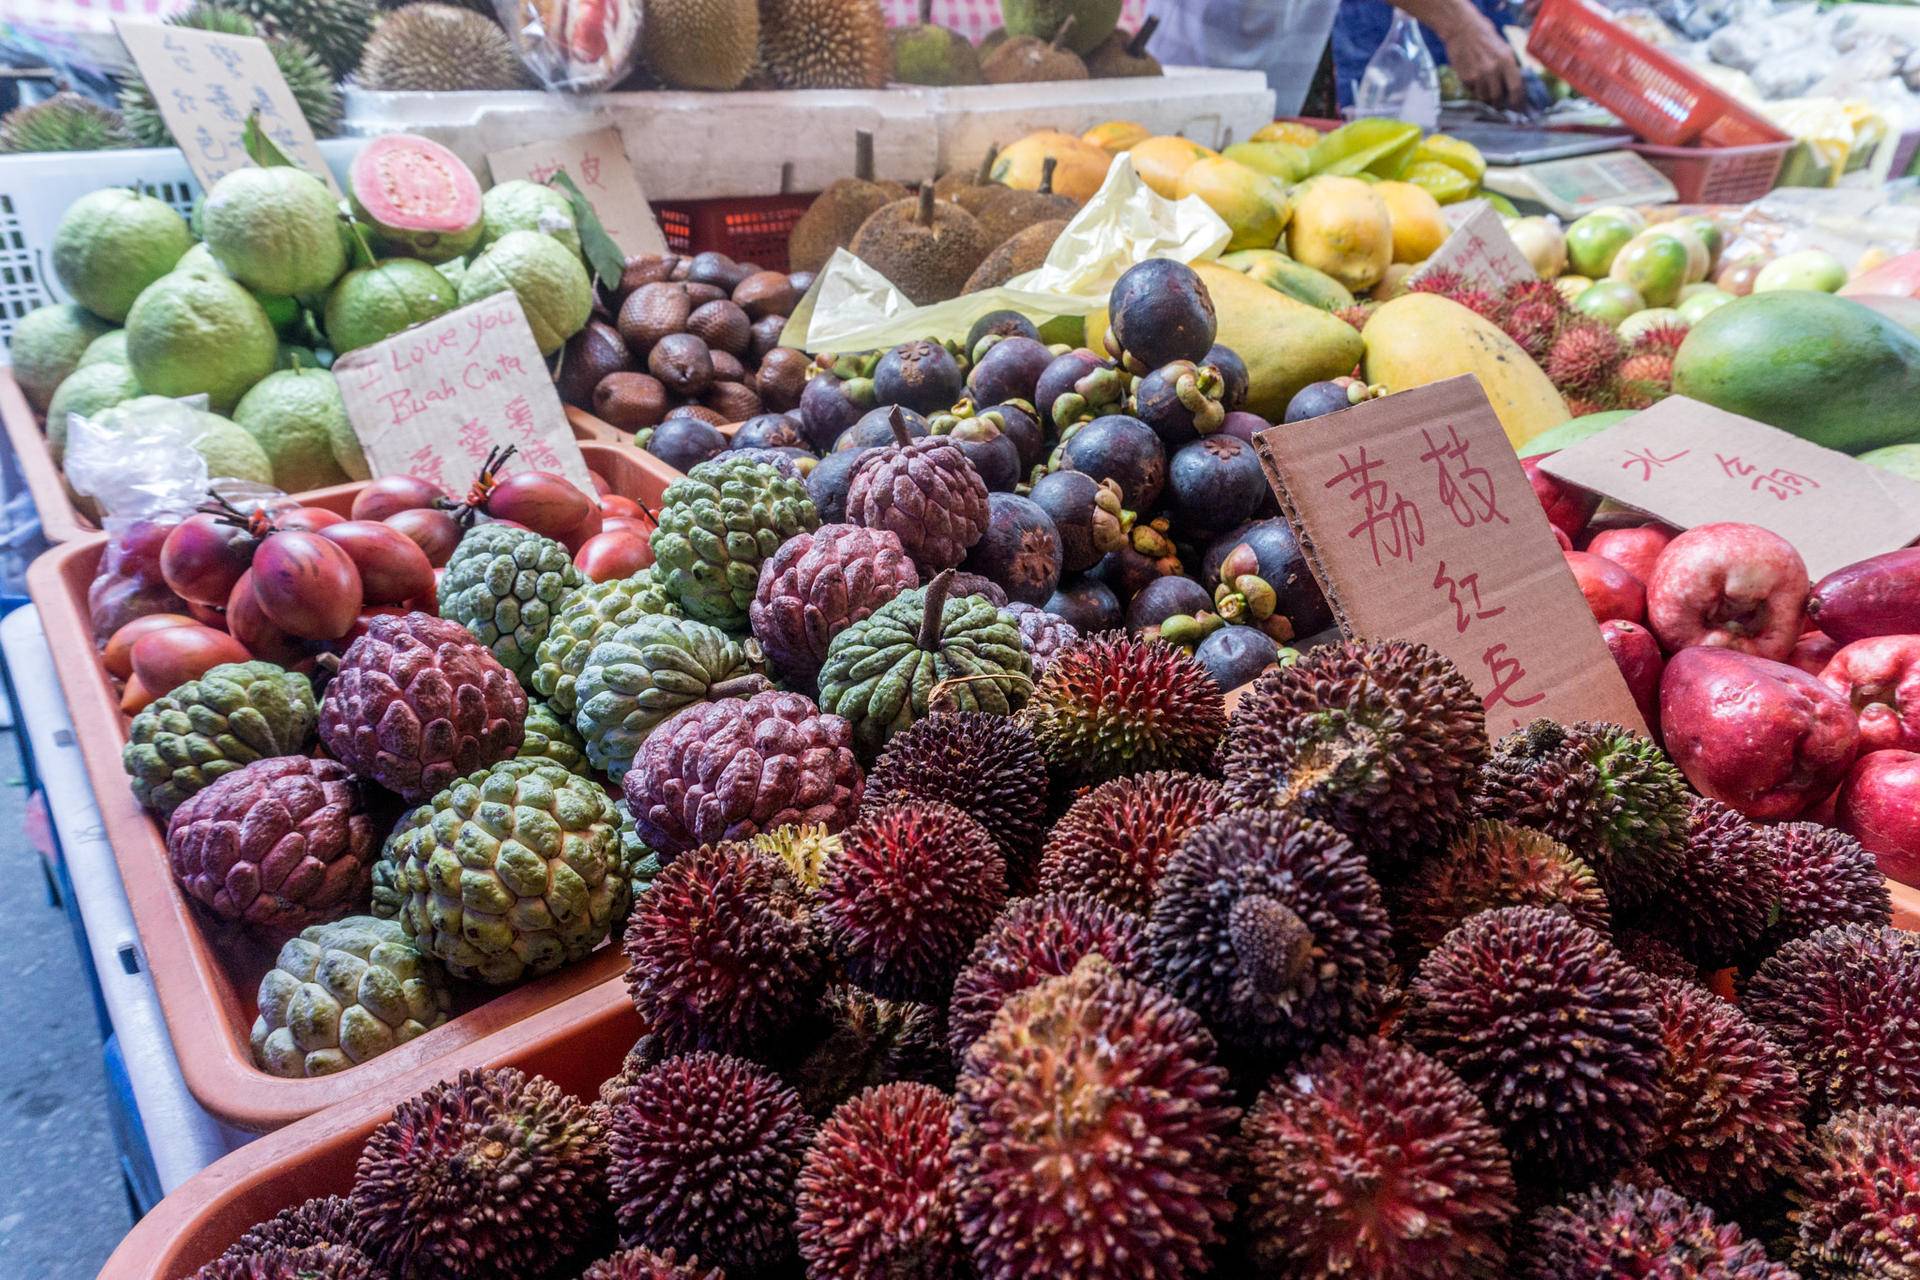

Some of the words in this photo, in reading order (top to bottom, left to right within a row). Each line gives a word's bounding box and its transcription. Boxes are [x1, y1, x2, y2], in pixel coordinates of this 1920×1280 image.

[377, 378, 456, 424] Buah
[463, 354, 527, 389] Cinta
[1325, 425, 1510, 566] 荔枝
[1433, 561, 1546, 727] 红毛
